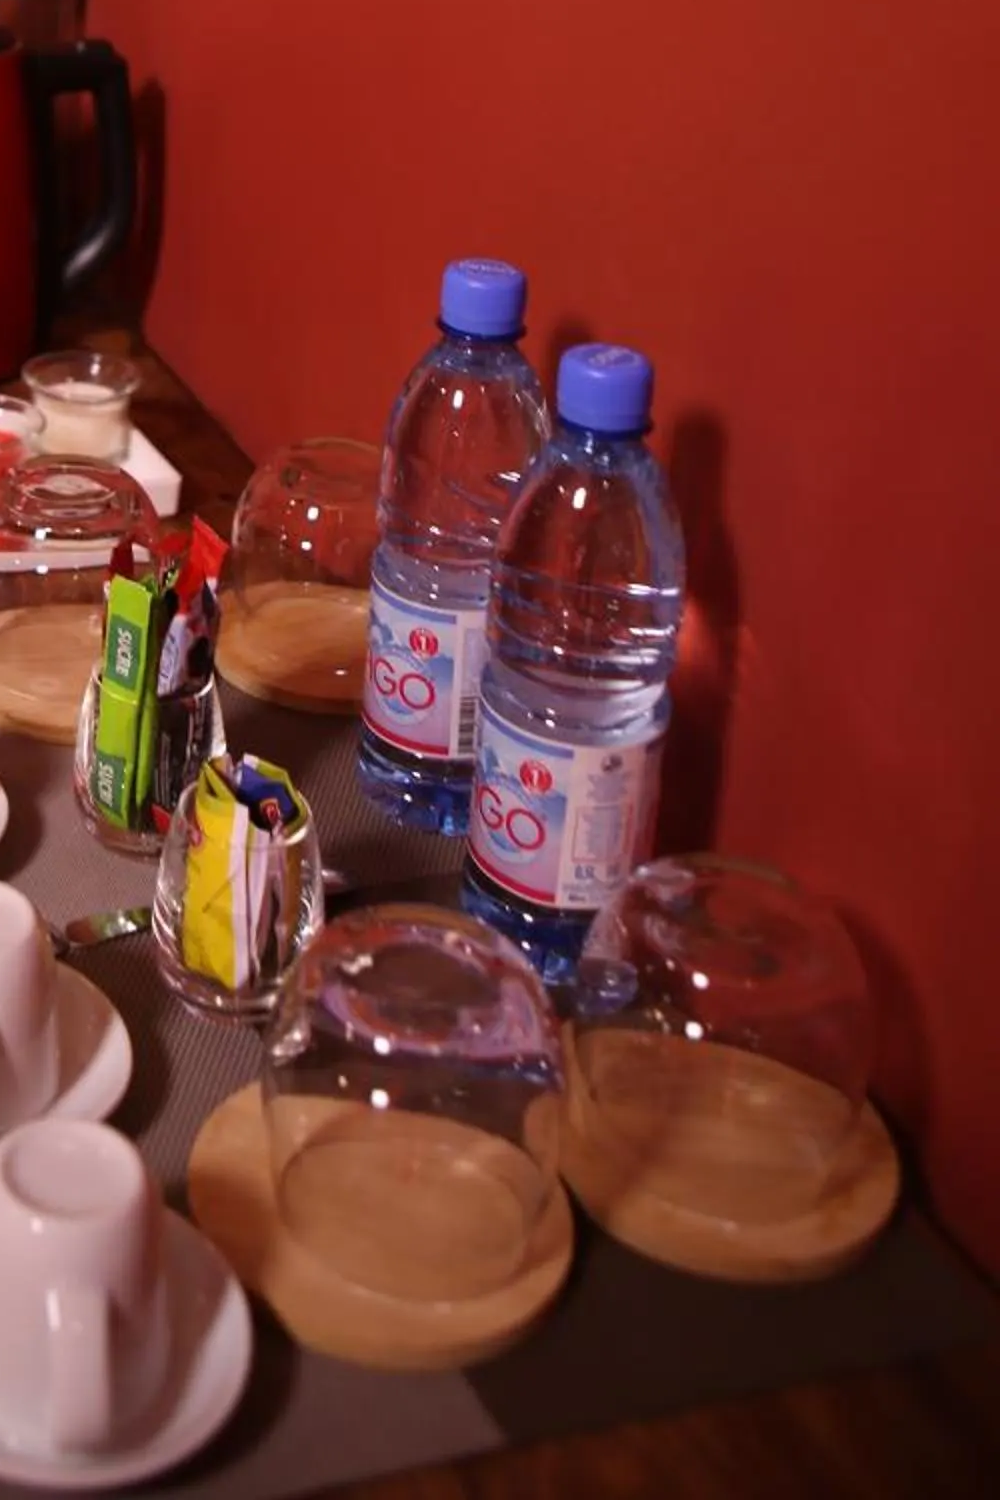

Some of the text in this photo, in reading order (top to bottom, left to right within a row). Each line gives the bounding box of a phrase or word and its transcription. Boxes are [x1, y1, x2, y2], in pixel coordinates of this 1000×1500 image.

[115, 627, 133, 677] SUCRE
[369, 654, 435, 710] GO
[475, 784, 546, 850] GO
